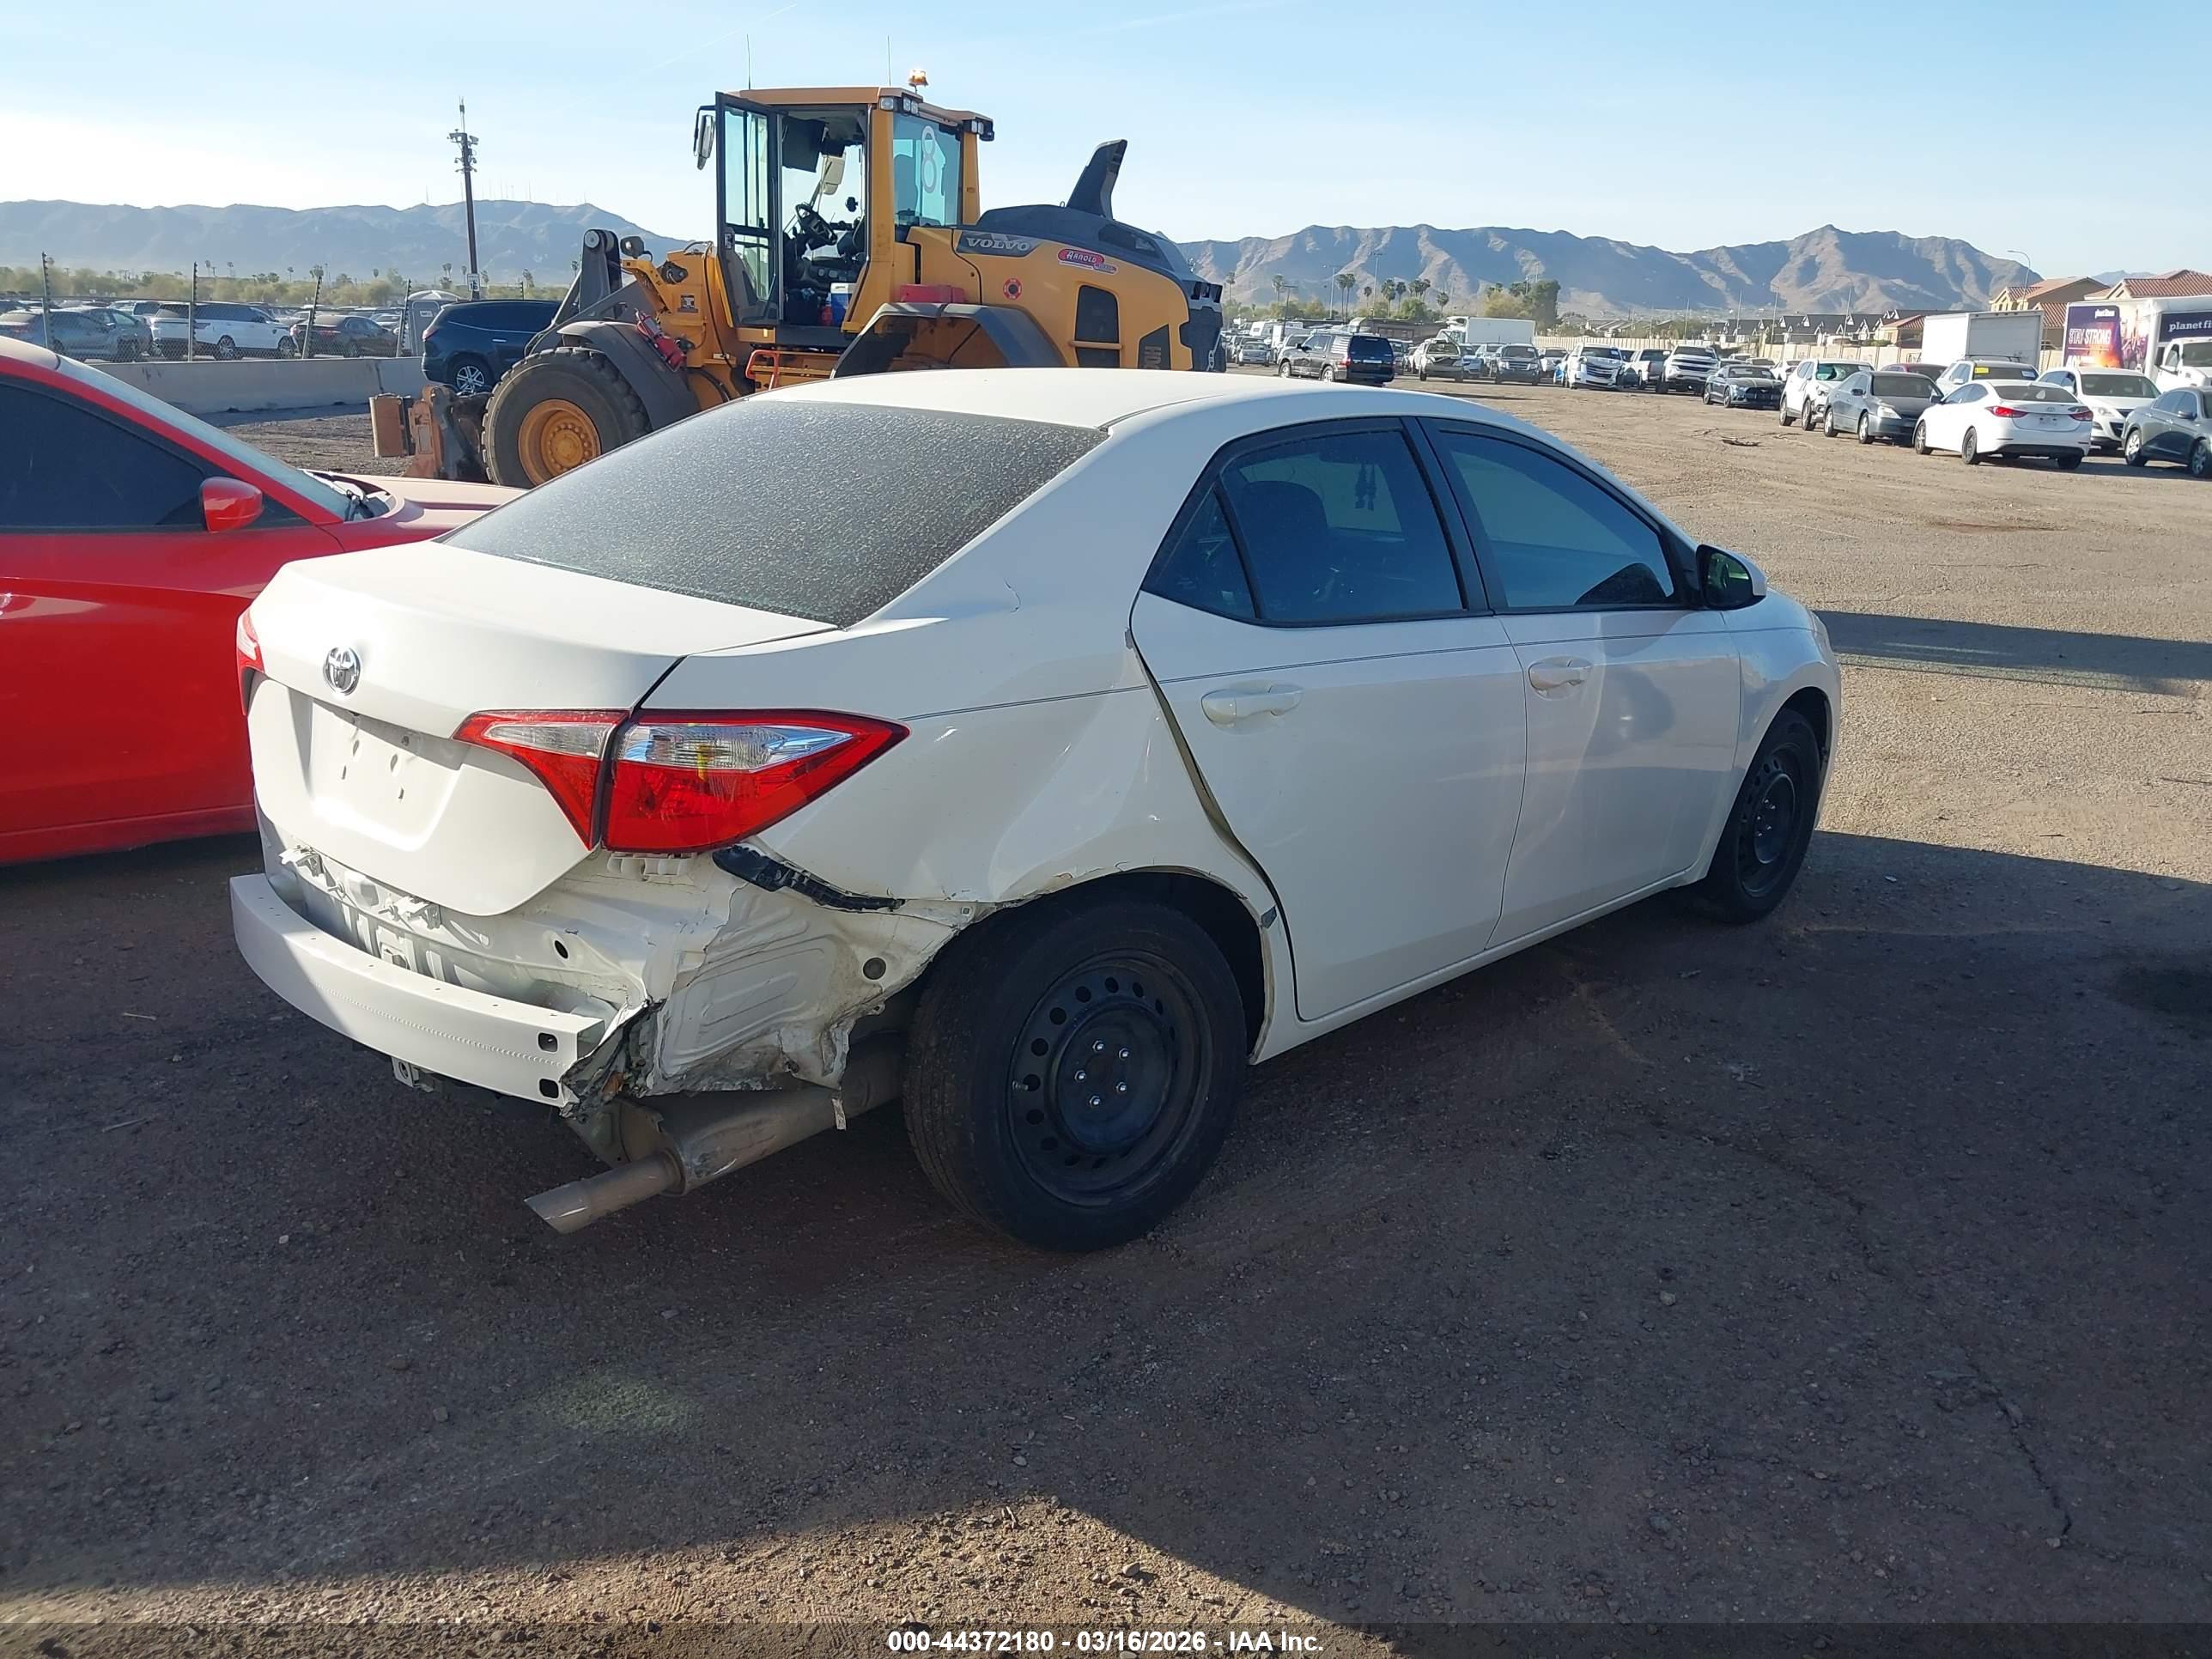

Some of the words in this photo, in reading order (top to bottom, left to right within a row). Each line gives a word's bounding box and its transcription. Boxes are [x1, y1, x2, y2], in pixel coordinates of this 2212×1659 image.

[921, 125, 937, 193] 8
[966, 237, 1030, 252] VOLVO
[2168, 321, 2203, 332] planet
[2084, 328, 2112, 345] STRONG
